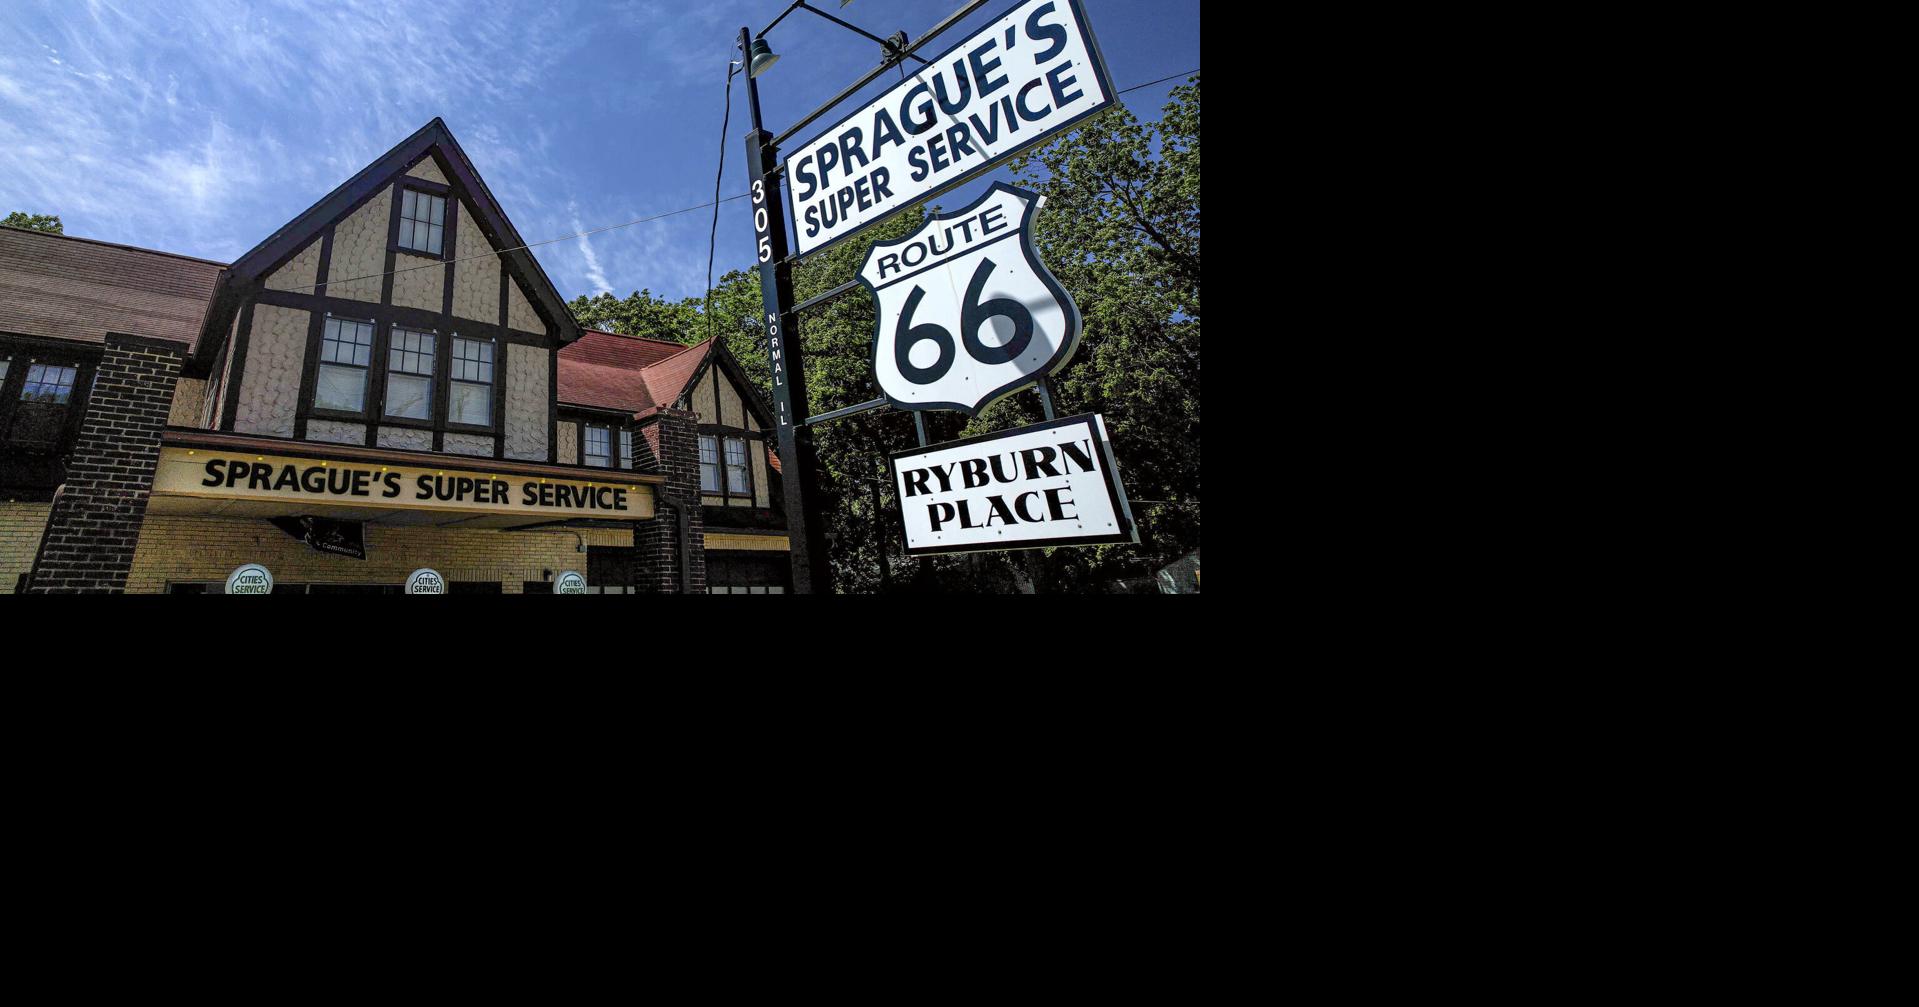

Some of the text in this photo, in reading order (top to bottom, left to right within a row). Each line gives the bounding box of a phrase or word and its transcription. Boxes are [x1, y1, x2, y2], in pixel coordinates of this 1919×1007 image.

[797, 0, 1069, 202] SPRAGUE'S
[804, 59, 1084, 238] SUPER SERVICE
[752, 180, 772, 263] 305
[877, 207, 1008, 280] ROUTE
[894, 257, 1034, 385] 66
[769, 313, 787, 425] NORMAL IL
[202, 459, 628, 511] SPRAGUE'S SUPER SERVICE
[901, 438, 1097, 500] RYBURN
[926, 485, 1080, 532] PLACE
[235, 585, 265, 594] SERVICE
[240, 576, 263, 584] CITIES
[418, 577, 438, 585] CITIES
